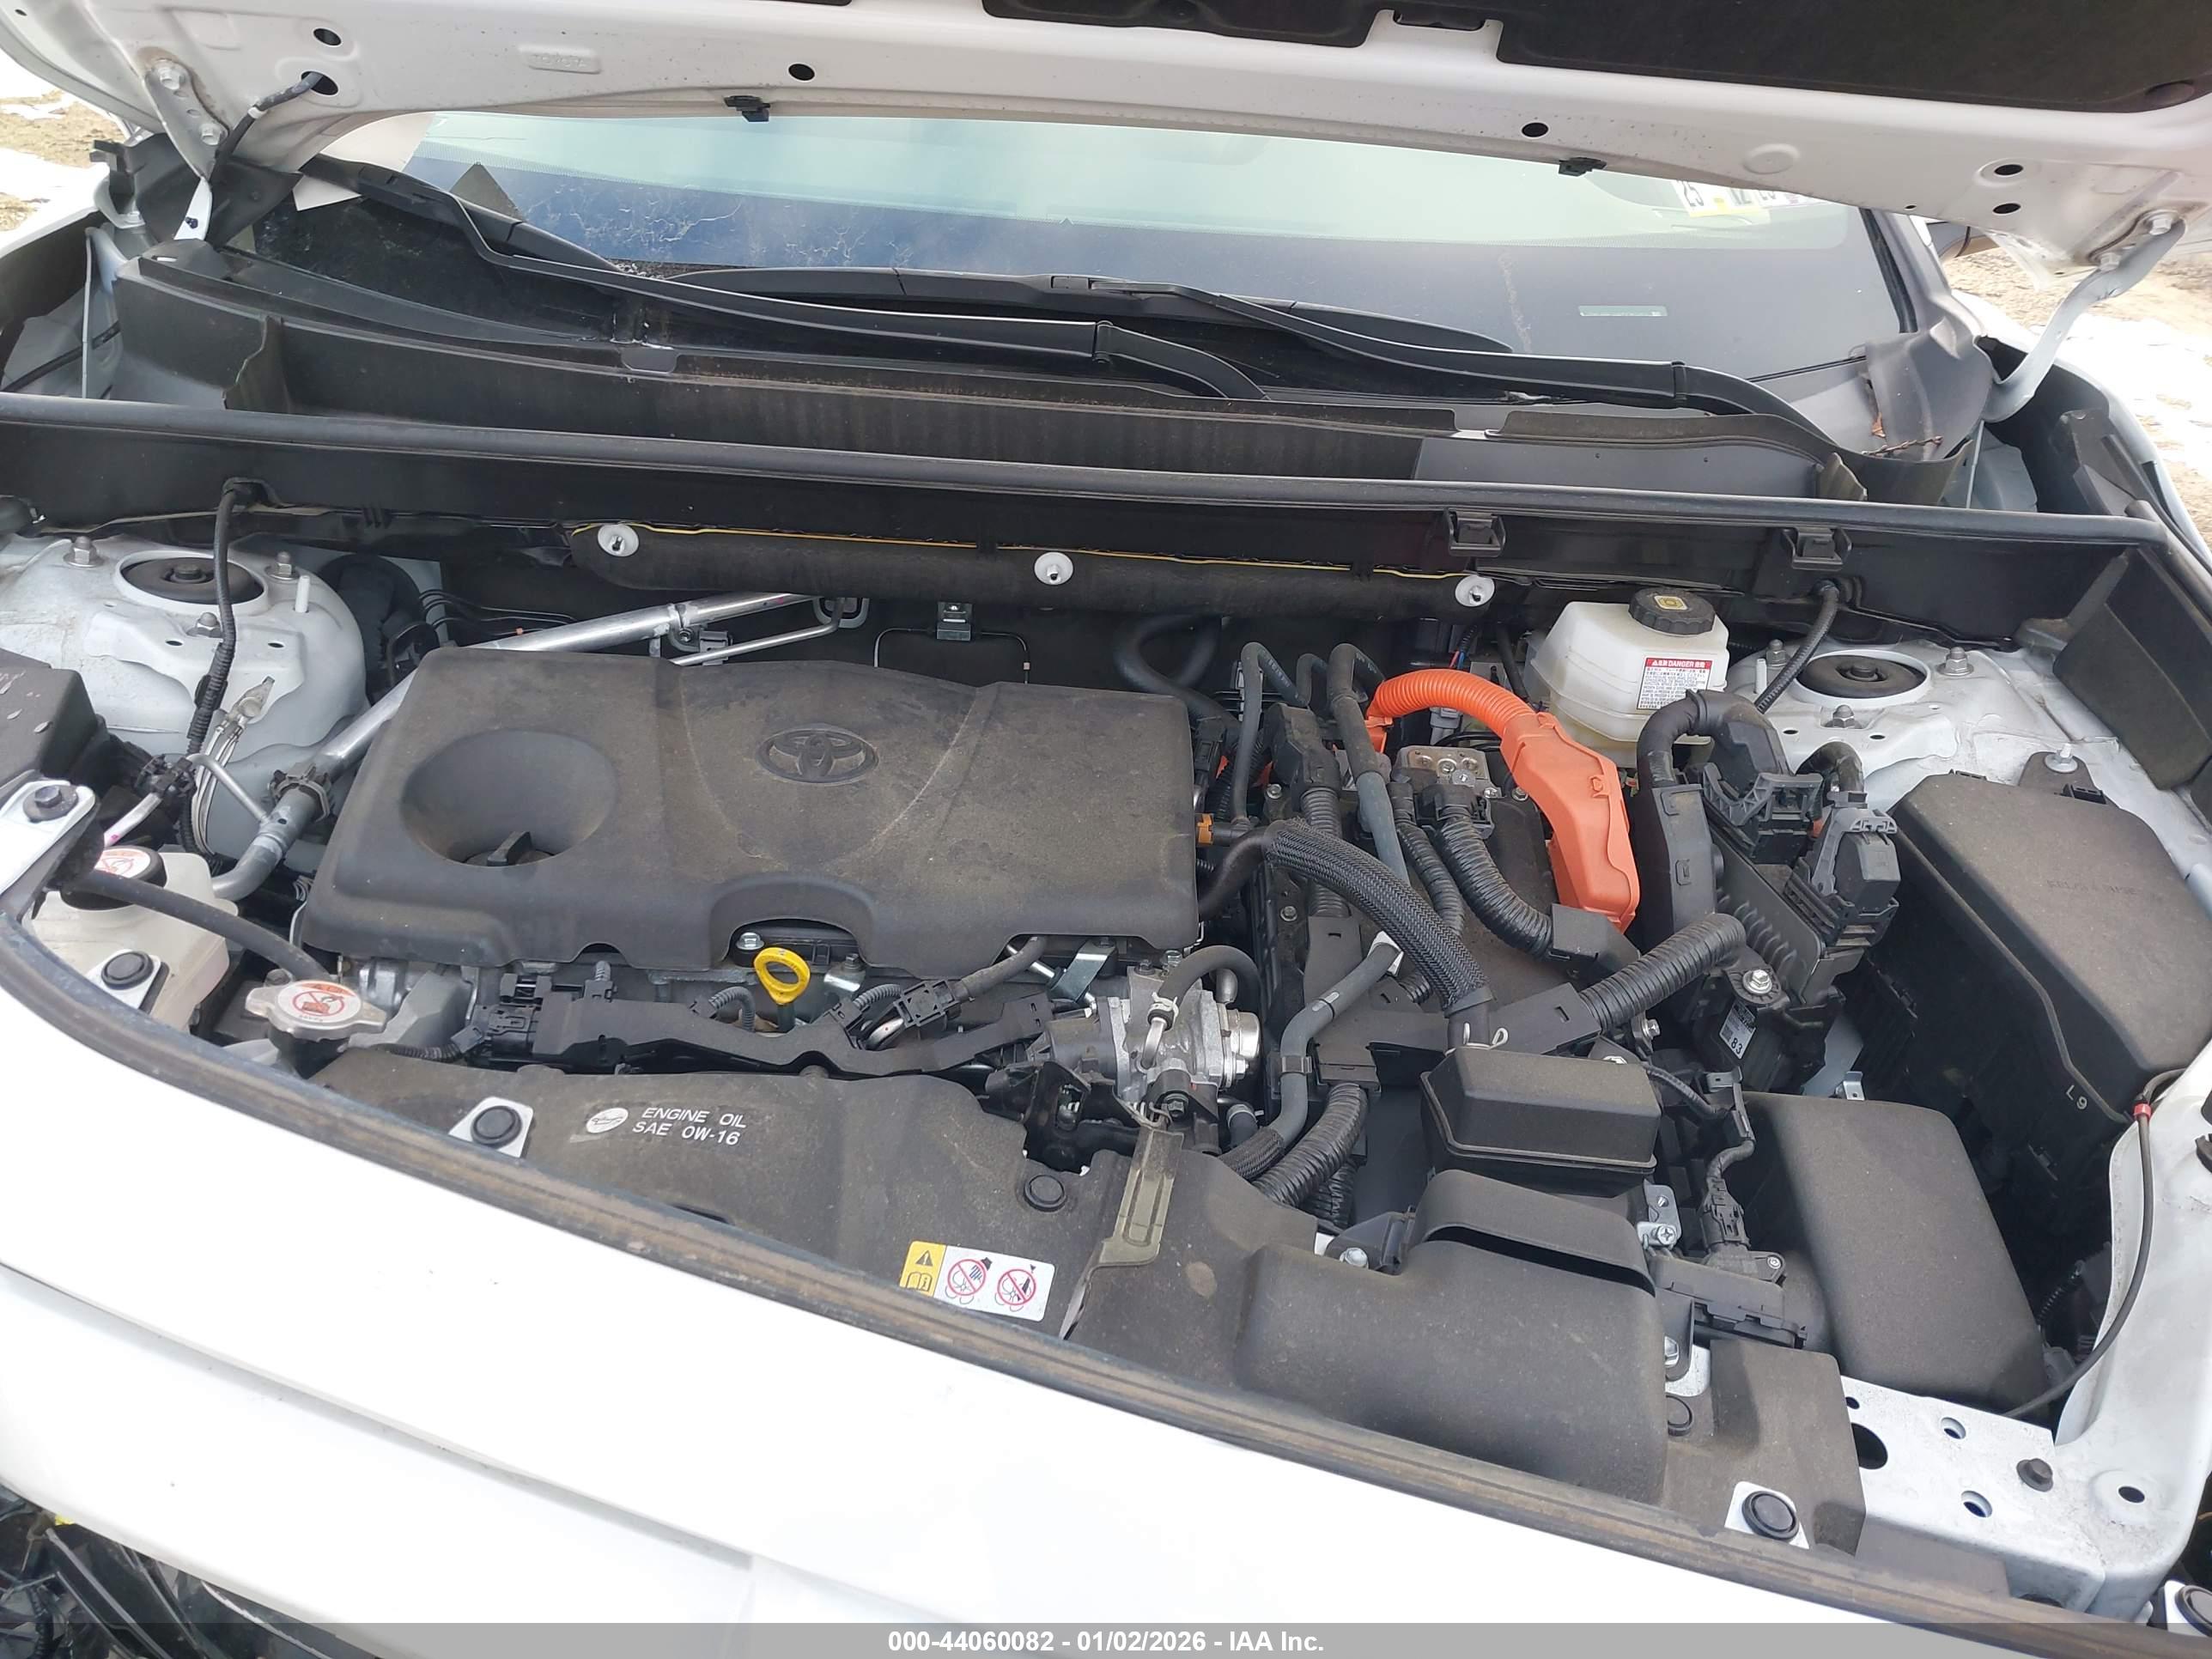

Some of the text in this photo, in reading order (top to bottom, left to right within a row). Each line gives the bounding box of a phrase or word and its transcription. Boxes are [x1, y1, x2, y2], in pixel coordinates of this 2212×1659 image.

[1731, 1037, 1743, 1054] 83
[641, 1107, 747, 1128] ENGINE OIL
[632, 1121, 740, 1146] SAE 0W-16
